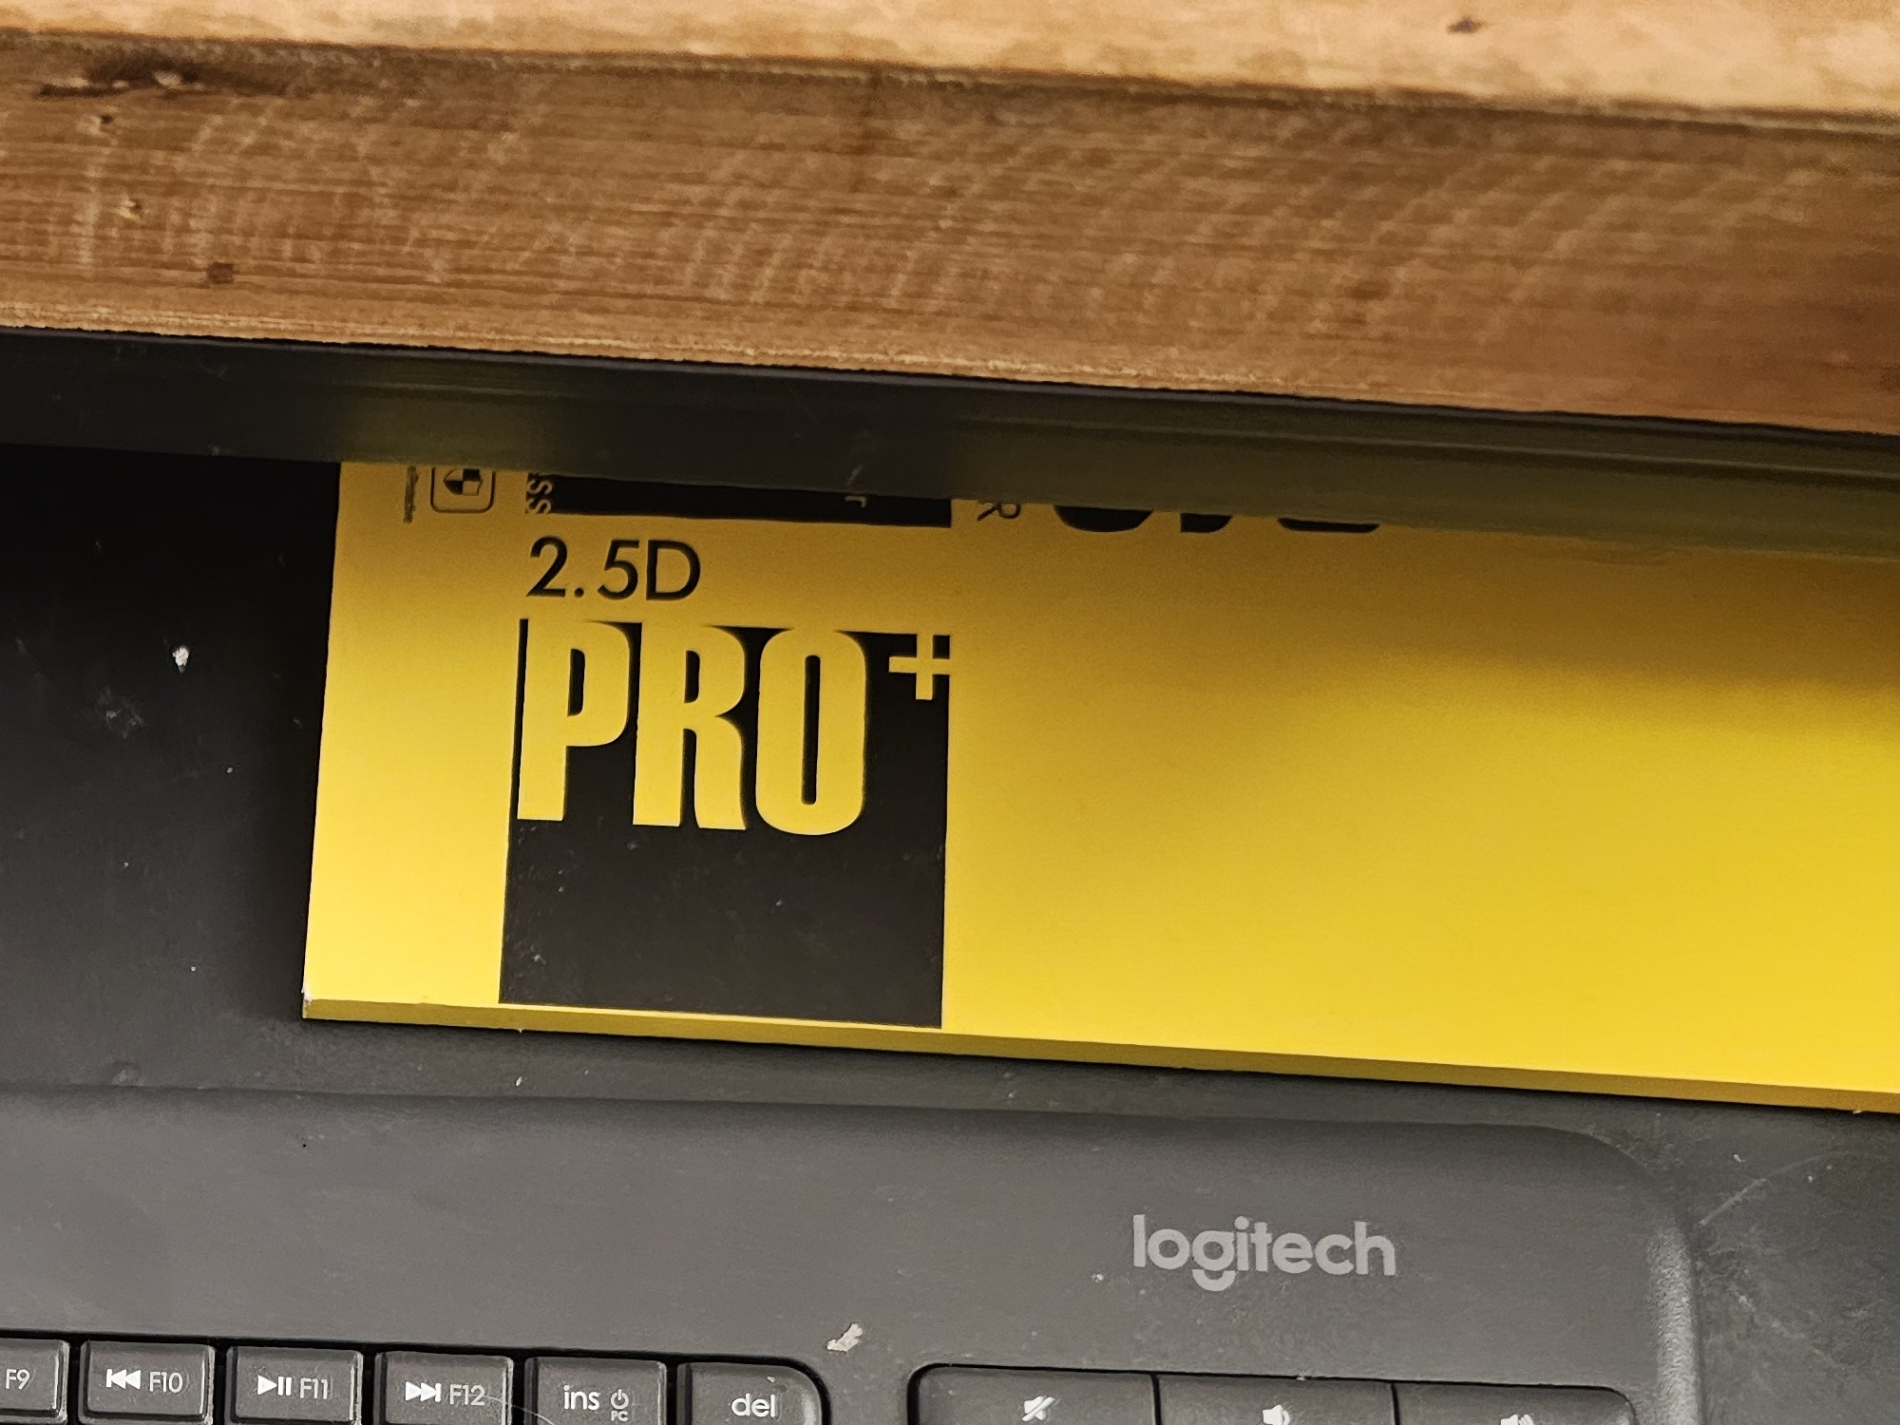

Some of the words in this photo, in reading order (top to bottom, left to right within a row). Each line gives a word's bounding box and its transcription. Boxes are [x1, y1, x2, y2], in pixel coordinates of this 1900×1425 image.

[526, 535, 702, 601] 2.5D
[1132, 1213, 1397, 1292] logitech
[4, 1368, 31, 1390] F9
[149, 1371, 184, 1394] F10
[299, 1376, 329, 1400] F11
[449, 1383, 486, 1407] F12
[563, 1384, 600, 1411] ins
[731, 1392, 777, 1418] del
[610, 1410, 630, 1422] PC
